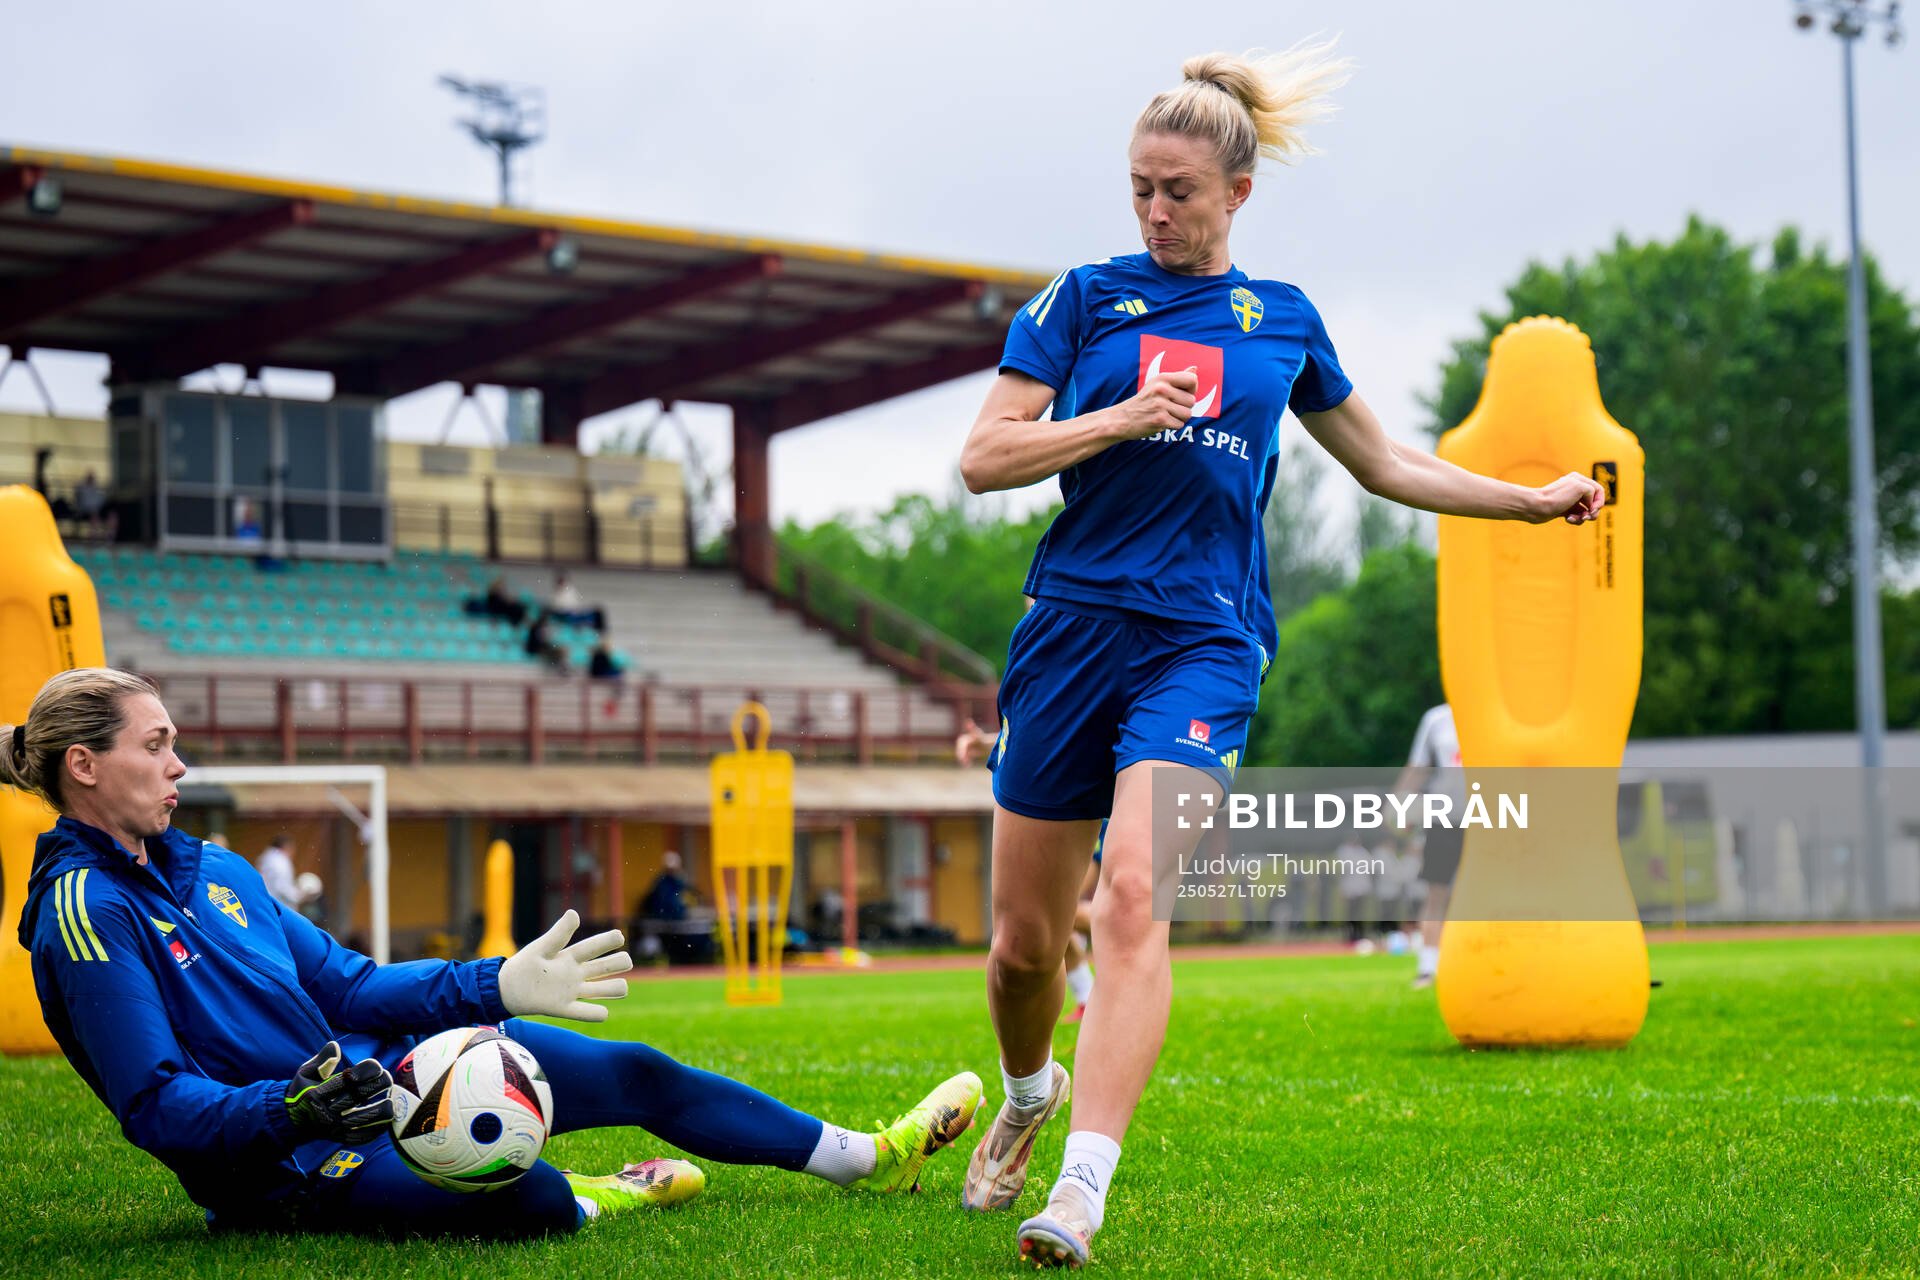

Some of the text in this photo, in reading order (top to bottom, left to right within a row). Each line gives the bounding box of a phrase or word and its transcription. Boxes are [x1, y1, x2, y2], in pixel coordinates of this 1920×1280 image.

[1202, 428, 1250, 461] SPEL
[1175, 737, 1217, 756] SVENSKA SPEL
